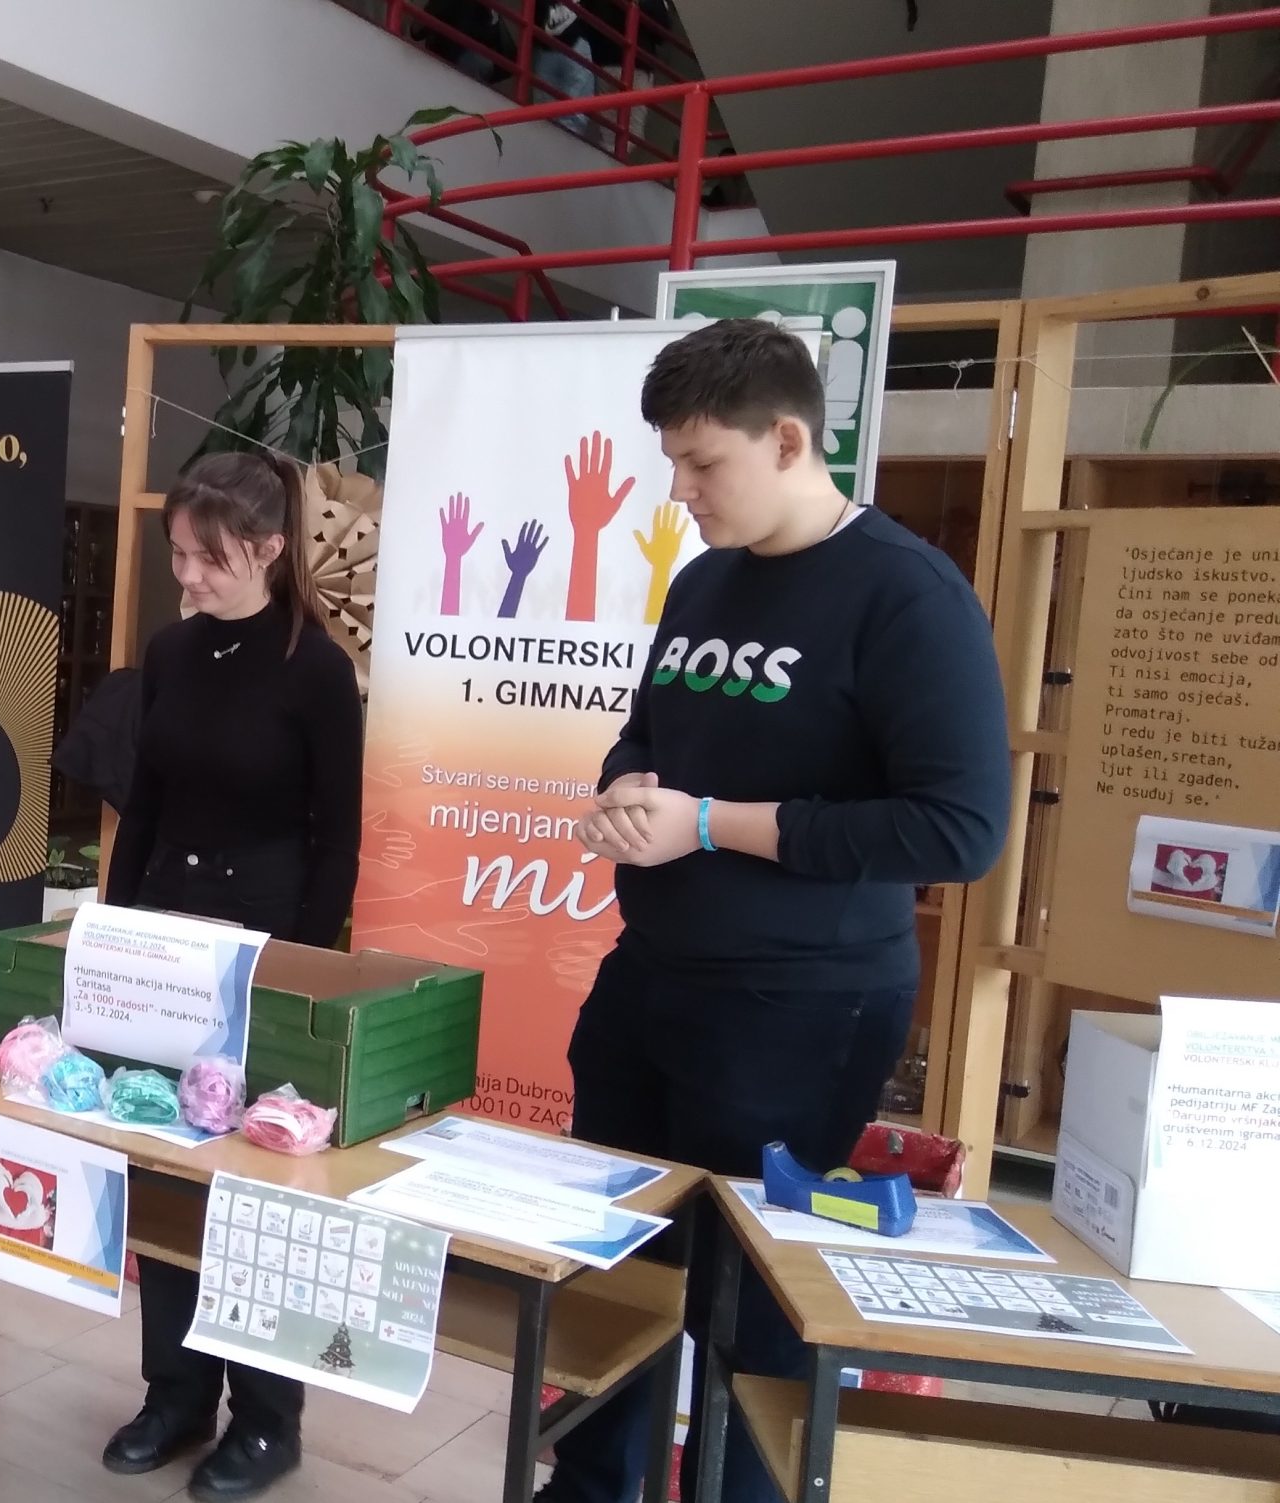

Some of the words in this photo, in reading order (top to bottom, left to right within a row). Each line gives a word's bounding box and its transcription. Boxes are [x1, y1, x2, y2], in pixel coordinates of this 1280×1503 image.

[1223, 548, 1242, 564] je
[1122, 566, 1183, 583] ljudsko
[1193, 568, 1275, 582] iskustvo.
[1118, 584, 1152, 600] Čini
[1163, 590, 1190, 601] nam
[1200, 591, 1218, 602] se
[1116, 606, 1133, 619] da
[1142, 607, 1225, 625] osjećanje
[1113, 627, 1148, 640] zato
[1158, 627, 1185, 641] što
[1195, 631, 1213, 643] ne
[404, 632, 634, 669] VOLONTERSKI
[1111, 646, 1200, 663] odvojivost
[1211, 651, 1249, 665] sebe
[1259, 653, 1278, 667] od
[652, 636, 803, 703] BOSS
[1109, 665, 1126, 678] Ti
[1135, 667, 1170, 681] nisi
[1180, 671, 1252, 688] emocija,
[462, 678, 484, 704] 1.
[1108, 685, 1124, 698] ti
[1134, 688, 1168, 701] samo
[1178, 690, 1249, 707] osjećaš.
[1105, 704, 1190, 725] Promatraj.
[1103, 723, 1112, 736] U
[1122, 726, 1155, 740] redu
[1166, 729, 1182, 744] je
[1191, 731, 1228, 747] biti
[422, 764, 483, 788] Stvari
[486, 773, 511, 791] se
[514, 776, 540, 793] ne
[1101, 761, 1133, 778] ljut
[1144, 766, 1167, 781] ili
[1096, 781, 1114, 795] Ne
[461, 850, 618, 921] mi
[82, 940, 124, 953] VOLONTERSKI
[124, 948, 141, 957] KLUB
[76, 966, 133, 985] Humanitarna
[135, 976, 163, 991] akcija
[166, 983, 212, 1002] Hrvatskog
[76, 977, 112, 993] Caritasa
[92, 993, 114, 1006] 1000
[160, 1008, 209, 1026] narukvice
[1183, 1054, 1256, 1066] VOLONTERSKI
[506, 1077, 574, 1105] Dubrov
[1172, 1083, 1252, 1099] Humanitarna
[1170, 1098, 1237, 1113] pedijatriju
[1240, 1102, 1259, 1112] MF
[1162, 1122, 1234, 1137] društvenim
